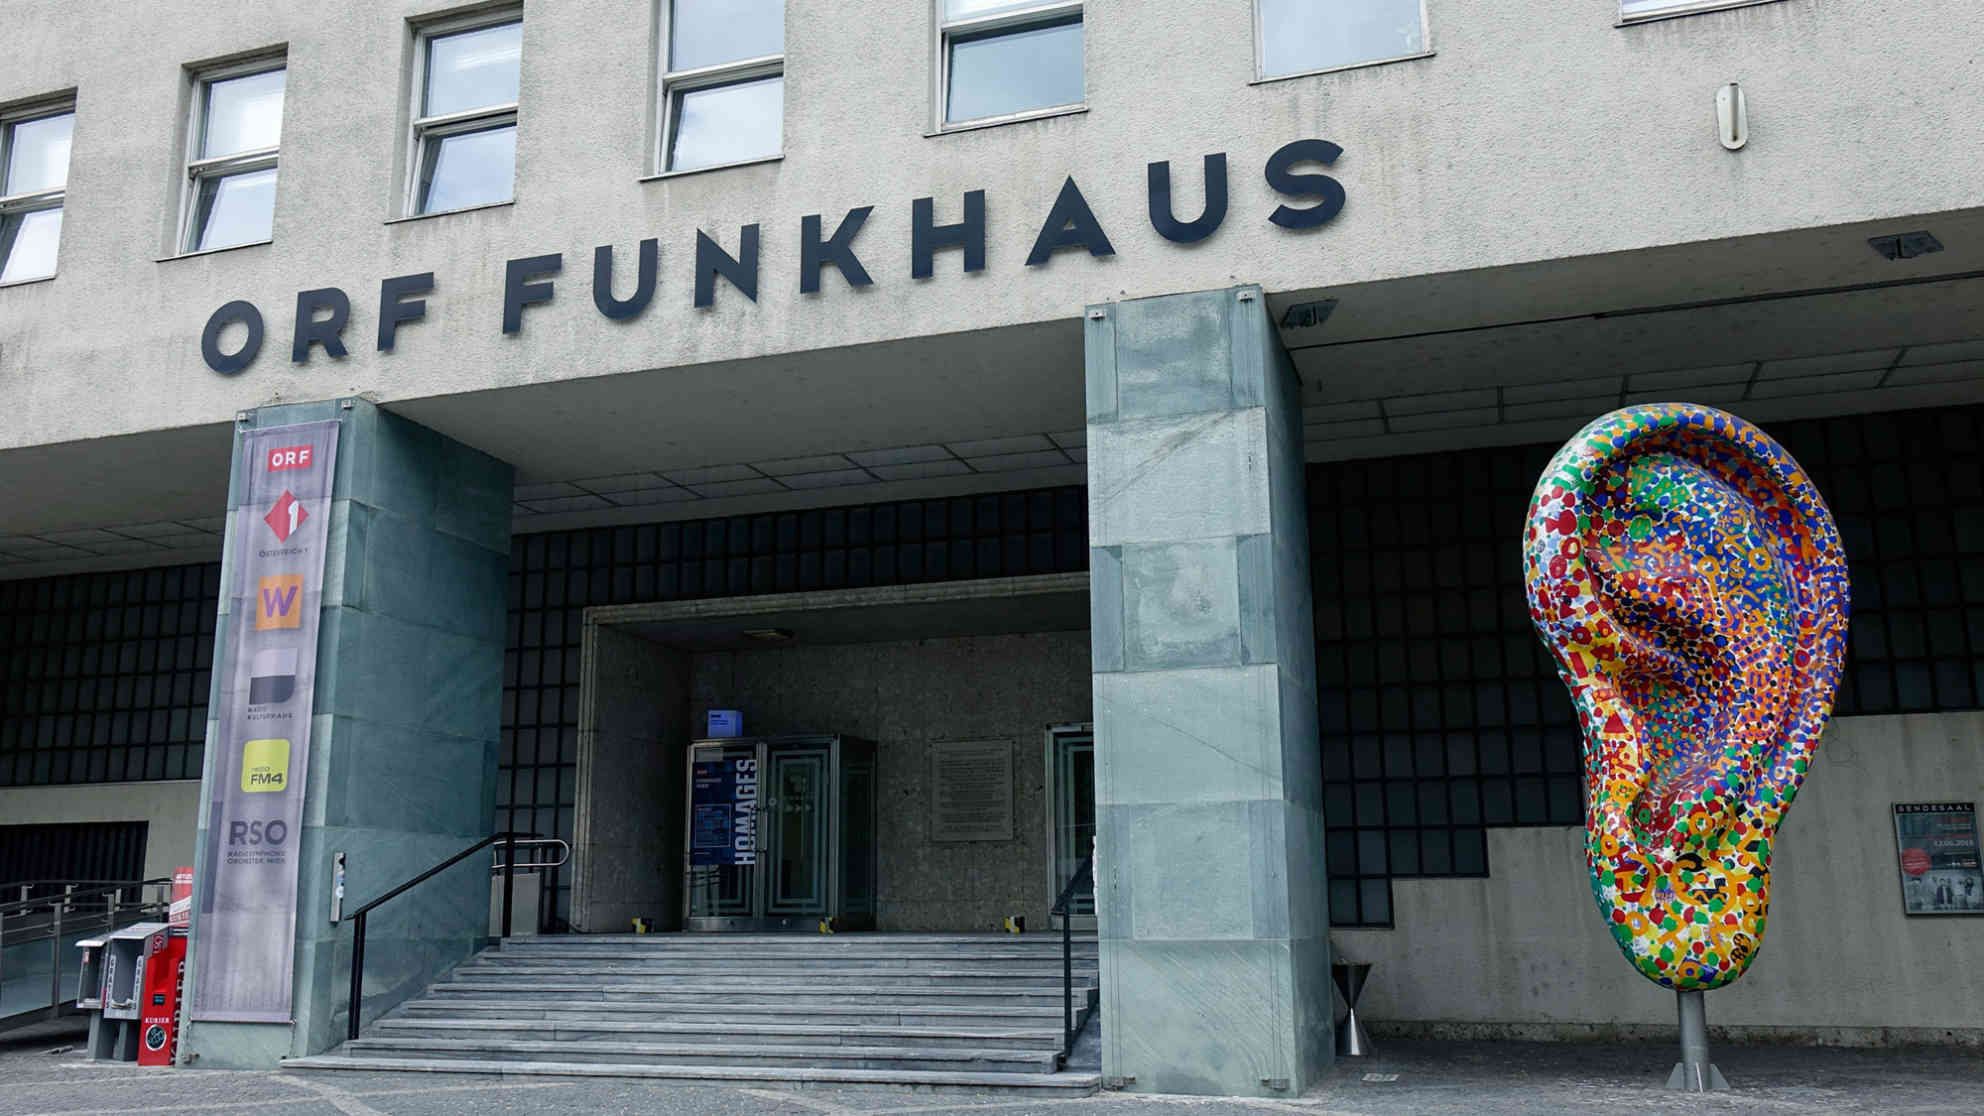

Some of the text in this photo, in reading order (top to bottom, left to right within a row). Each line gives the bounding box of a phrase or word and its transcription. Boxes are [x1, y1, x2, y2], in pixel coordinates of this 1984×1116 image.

[201, 139, 1347, 375] ORF FUNKHAUS
[271, 450, 310, 467] ORF
[288, 501, 299, 535] 1
[262, 585, 298, 617] W
[250, 772, 283, 784] FM4
[734, 760, 757, 865] HOMAGES
[1898, 804, 1971, 813] SENDESAAL
[228, 820, 288, 846] RSO
